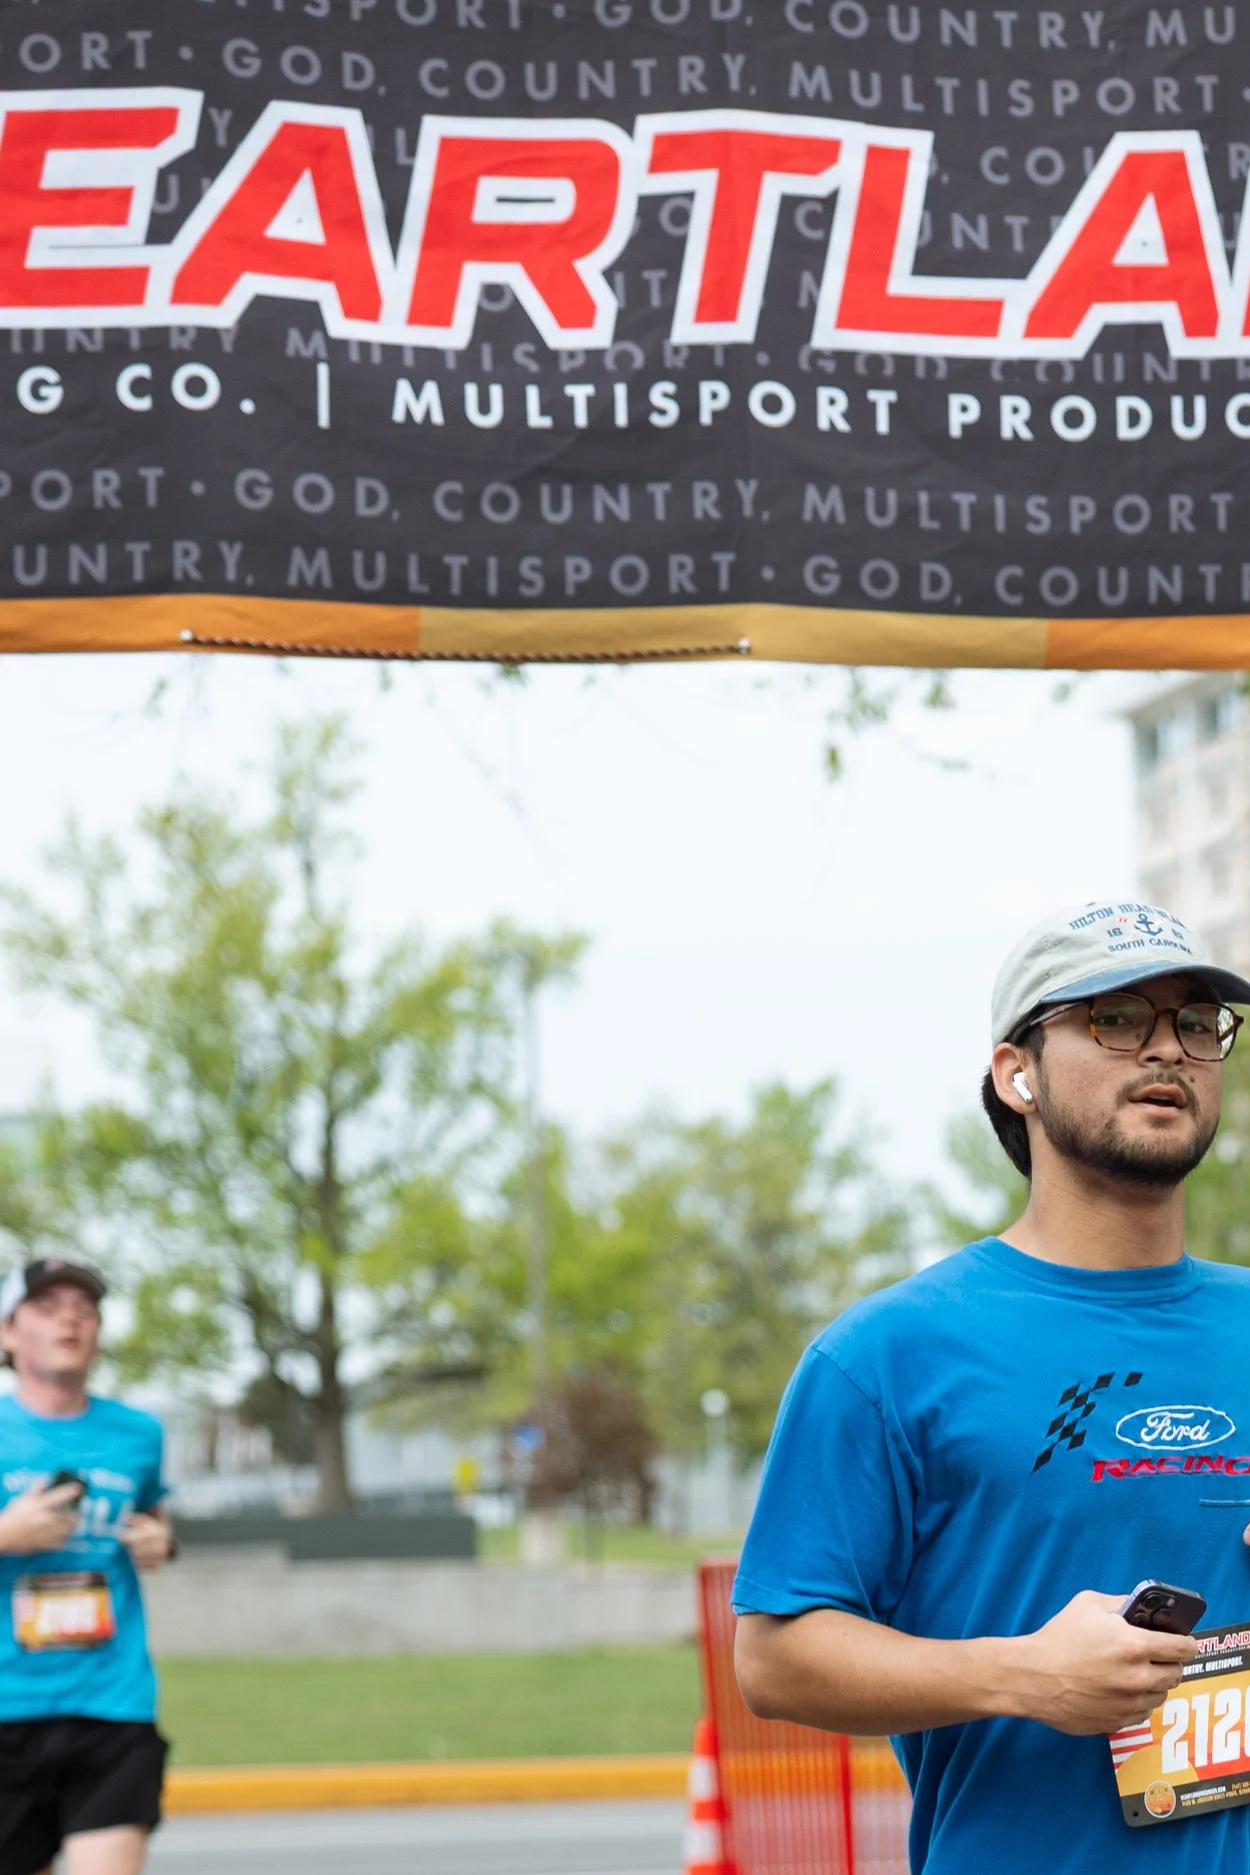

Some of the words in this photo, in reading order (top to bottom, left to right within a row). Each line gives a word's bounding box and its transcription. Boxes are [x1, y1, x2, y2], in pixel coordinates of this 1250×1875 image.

[785, 0, 1115, 51] COUNTRY,
[223, 38, 385, 95] GOD,
[419, 53, 756, 101] COUNTRY,
[789, 61, 1219, 118] MULTISPORT
[117, 363, 255, 414] CO.
[393, 379, 897, 434] MULTISPORT
[235, 469, 399, 520] GOD,
[433, 479, 770, 524] COUNTRY,
[802, 483, 1232, 534] MULTISPORT
[288, 547, 736, 596] MULTISPORT
[803, 555, 961, 603] GOD,
[1069, 906, 1115, 931] HILTON
[1107, 938, 1145, 953] SOUTH
[1140, 1411, 1210, 1442] Ford
[1197, 1630, 1250, 1653] RTLAND
